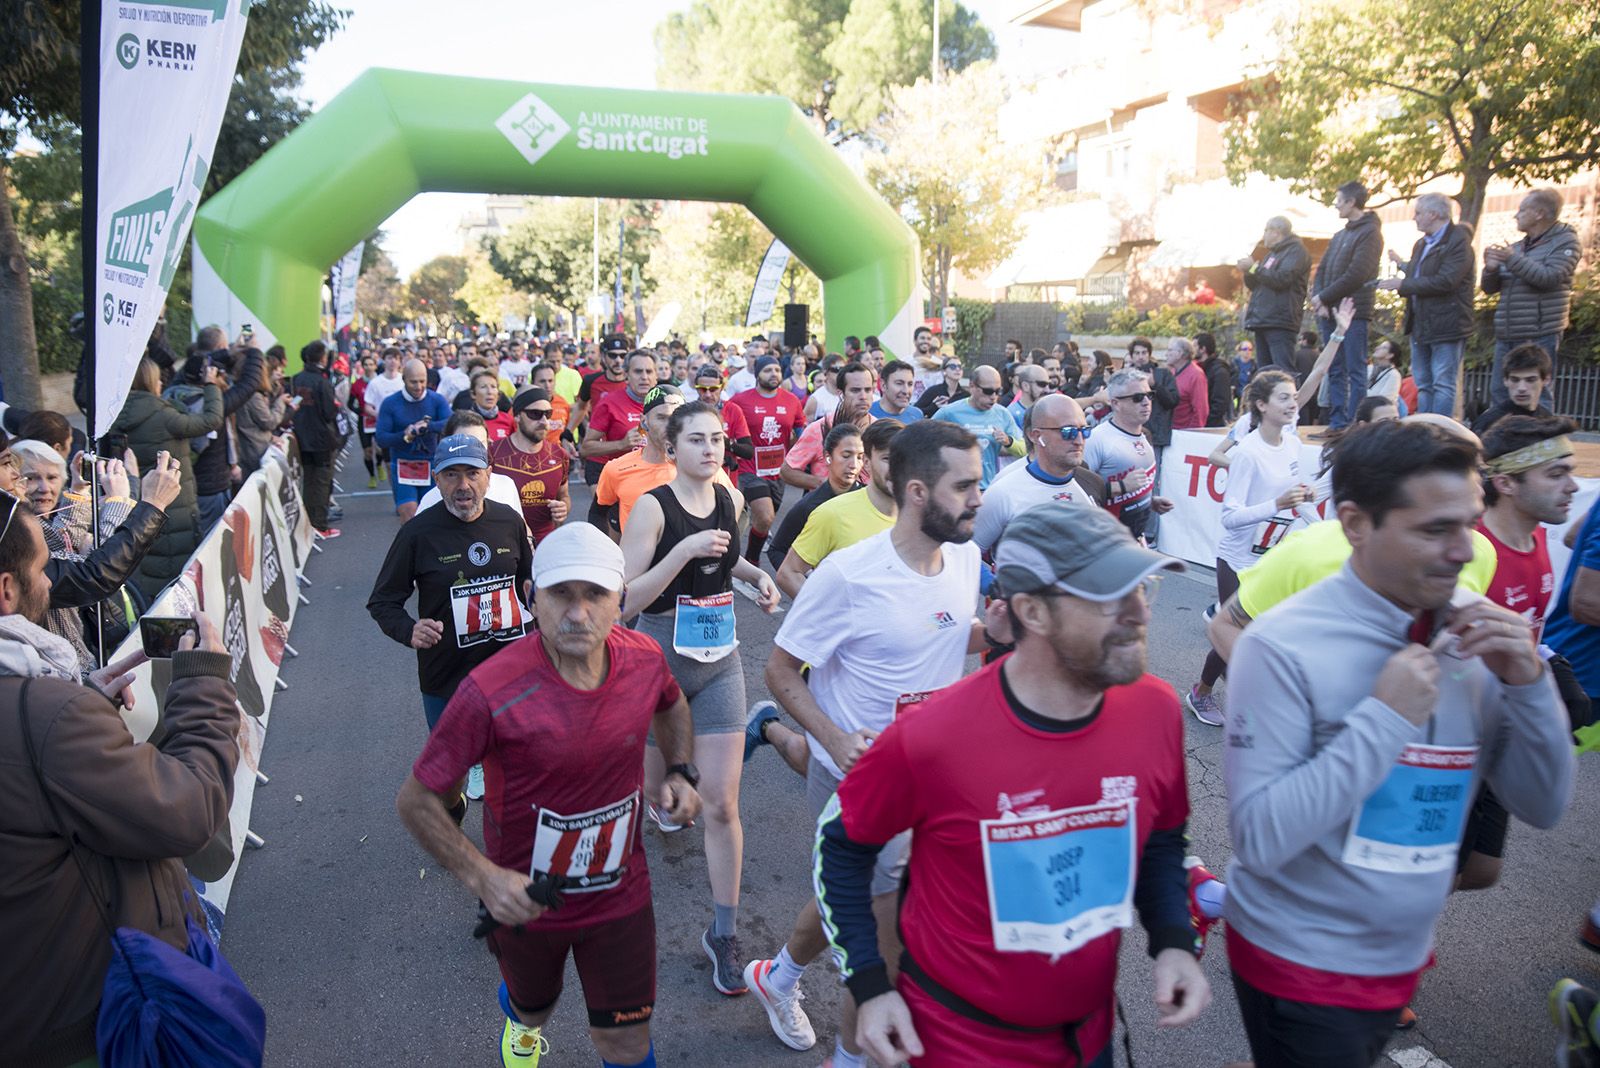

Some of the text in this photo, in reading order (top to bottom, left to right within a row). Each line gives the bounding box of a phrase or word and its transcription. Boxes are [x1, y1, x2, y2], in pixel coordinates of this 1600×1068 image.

[137, 9, 144, 21] Y
[147, 39, 196, 61] KERN
[577, 111, 709, 133] AJUNTAMENT DE
[576, 127, 709, 160] SantCugat
[470, 585, 487, 596] SANT
[703, 625, 719, 641] 638
